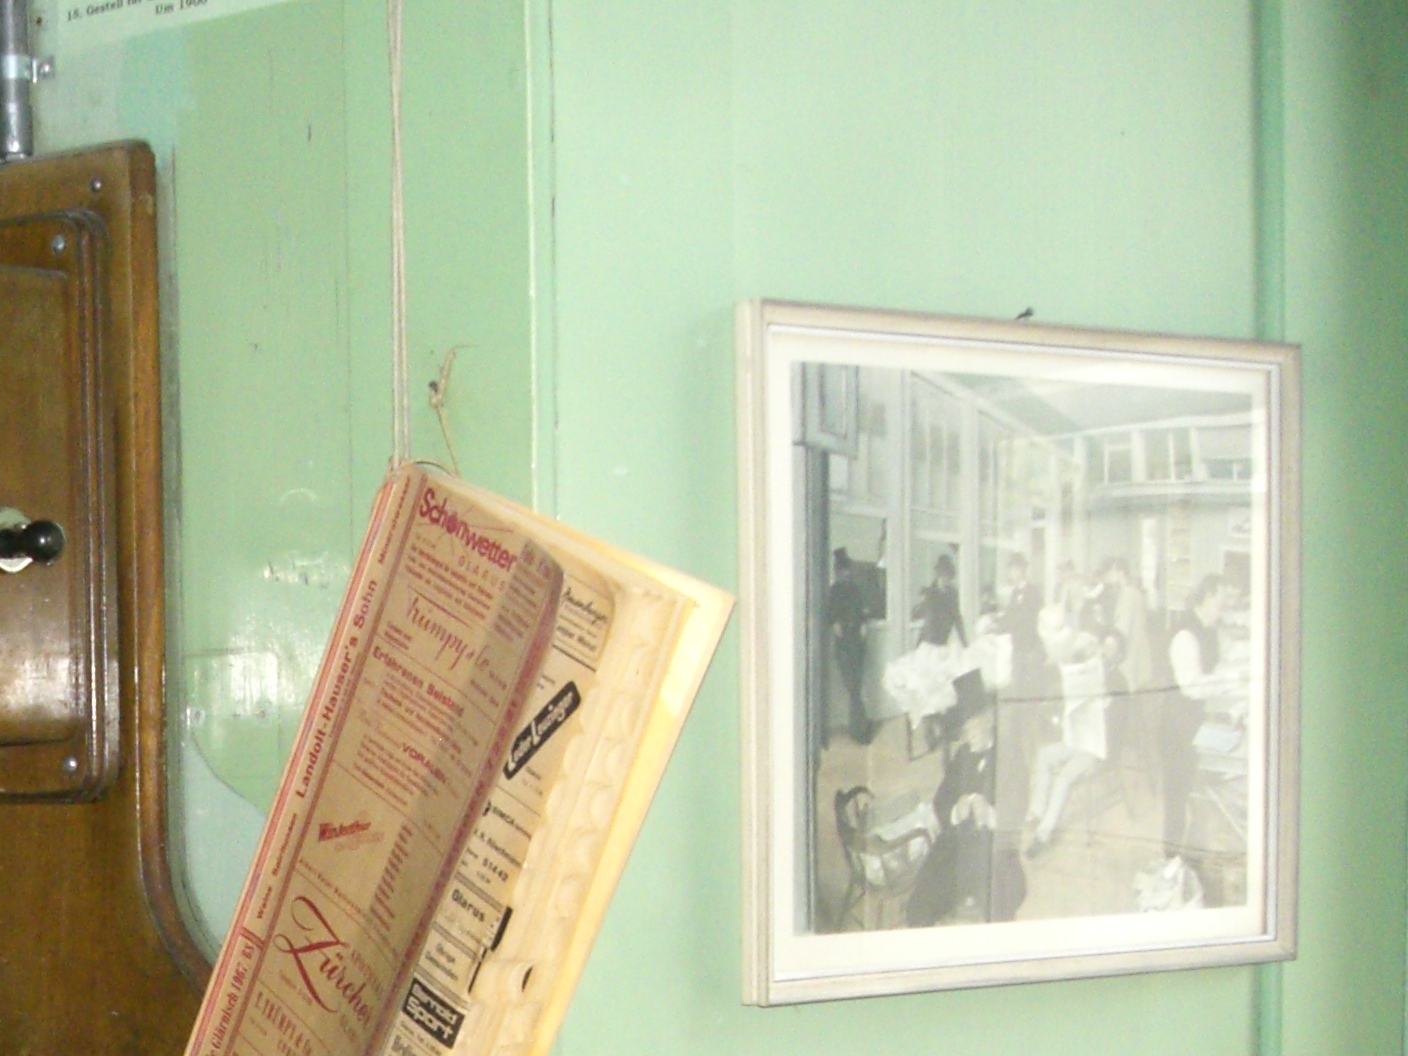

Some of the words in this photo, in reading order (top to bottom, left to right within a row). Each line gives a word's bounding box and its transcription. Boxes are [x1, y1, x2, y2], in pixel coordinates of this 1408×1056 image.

[155, 5, 175, 16] Um
[295, 635, 359, 799] Landolt-Hauser's
[353, 579, 379, 629] Sohn
[452, 888, 485, 922] Glarus
[405, 995, 454, 1040] Sport
